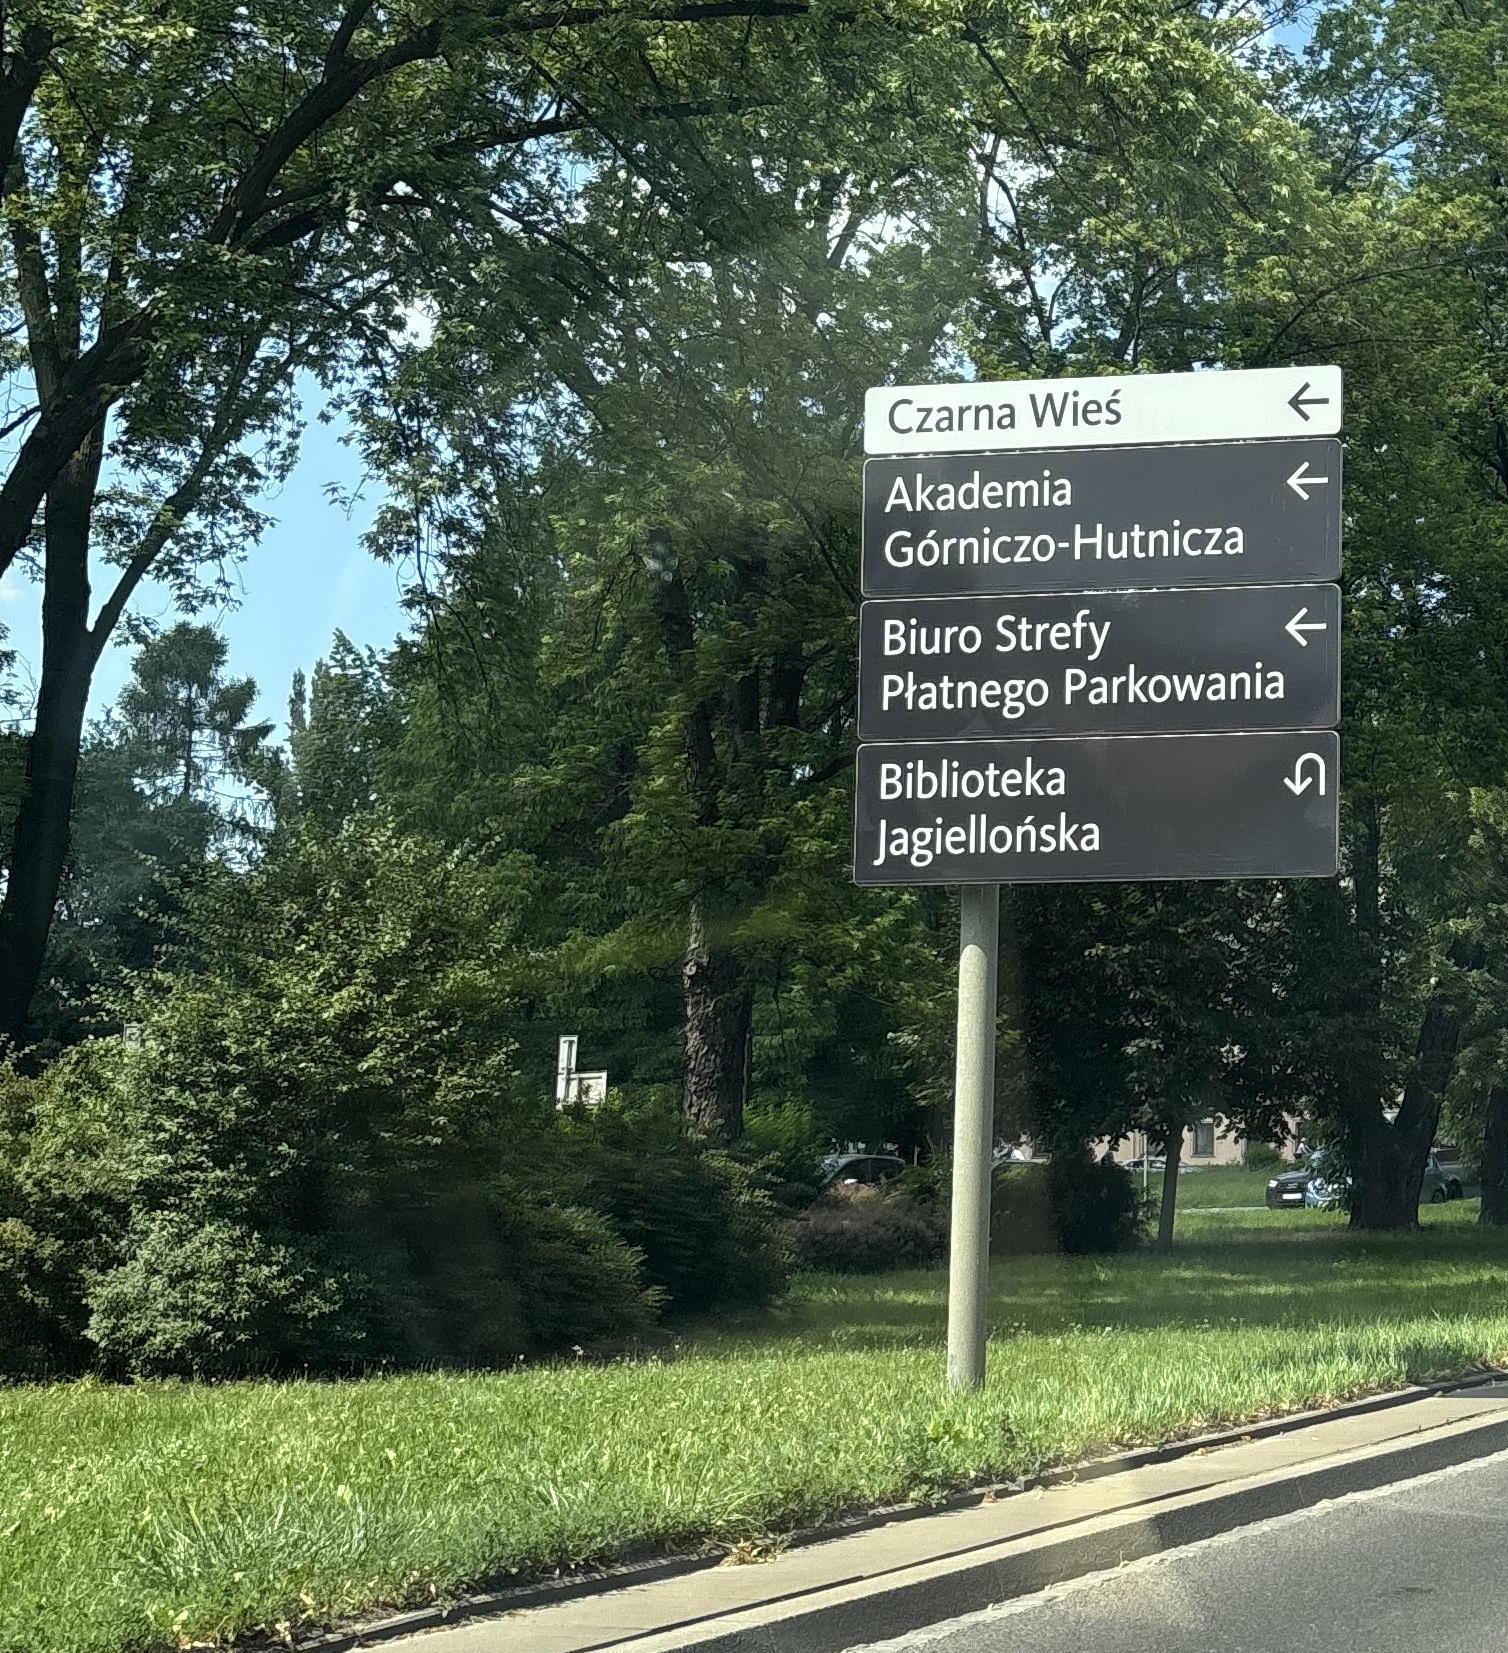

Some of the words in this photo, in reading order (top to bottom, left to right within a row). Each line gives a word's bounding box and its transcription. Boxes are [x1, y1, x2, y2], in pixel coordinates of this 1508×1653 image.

[888, 398, 1016, 434] Czarna
[1029, 389, 1122, 428] Wieś
[884, 469, 1072, 513] Akademia
[884, 519, 1244, 568] Górniczo-Hutnicza
[883, 617, 982, 656] Biuro
[995, 609, 1112, 661] Strefy
[882, 671, 1049, 719] Płatnego
[1064, 661, 1285, 705] Parkowania
[880, 756, 1066, 800] Biblioteka
[873, 811, 1100, 867] Jagiellońska
